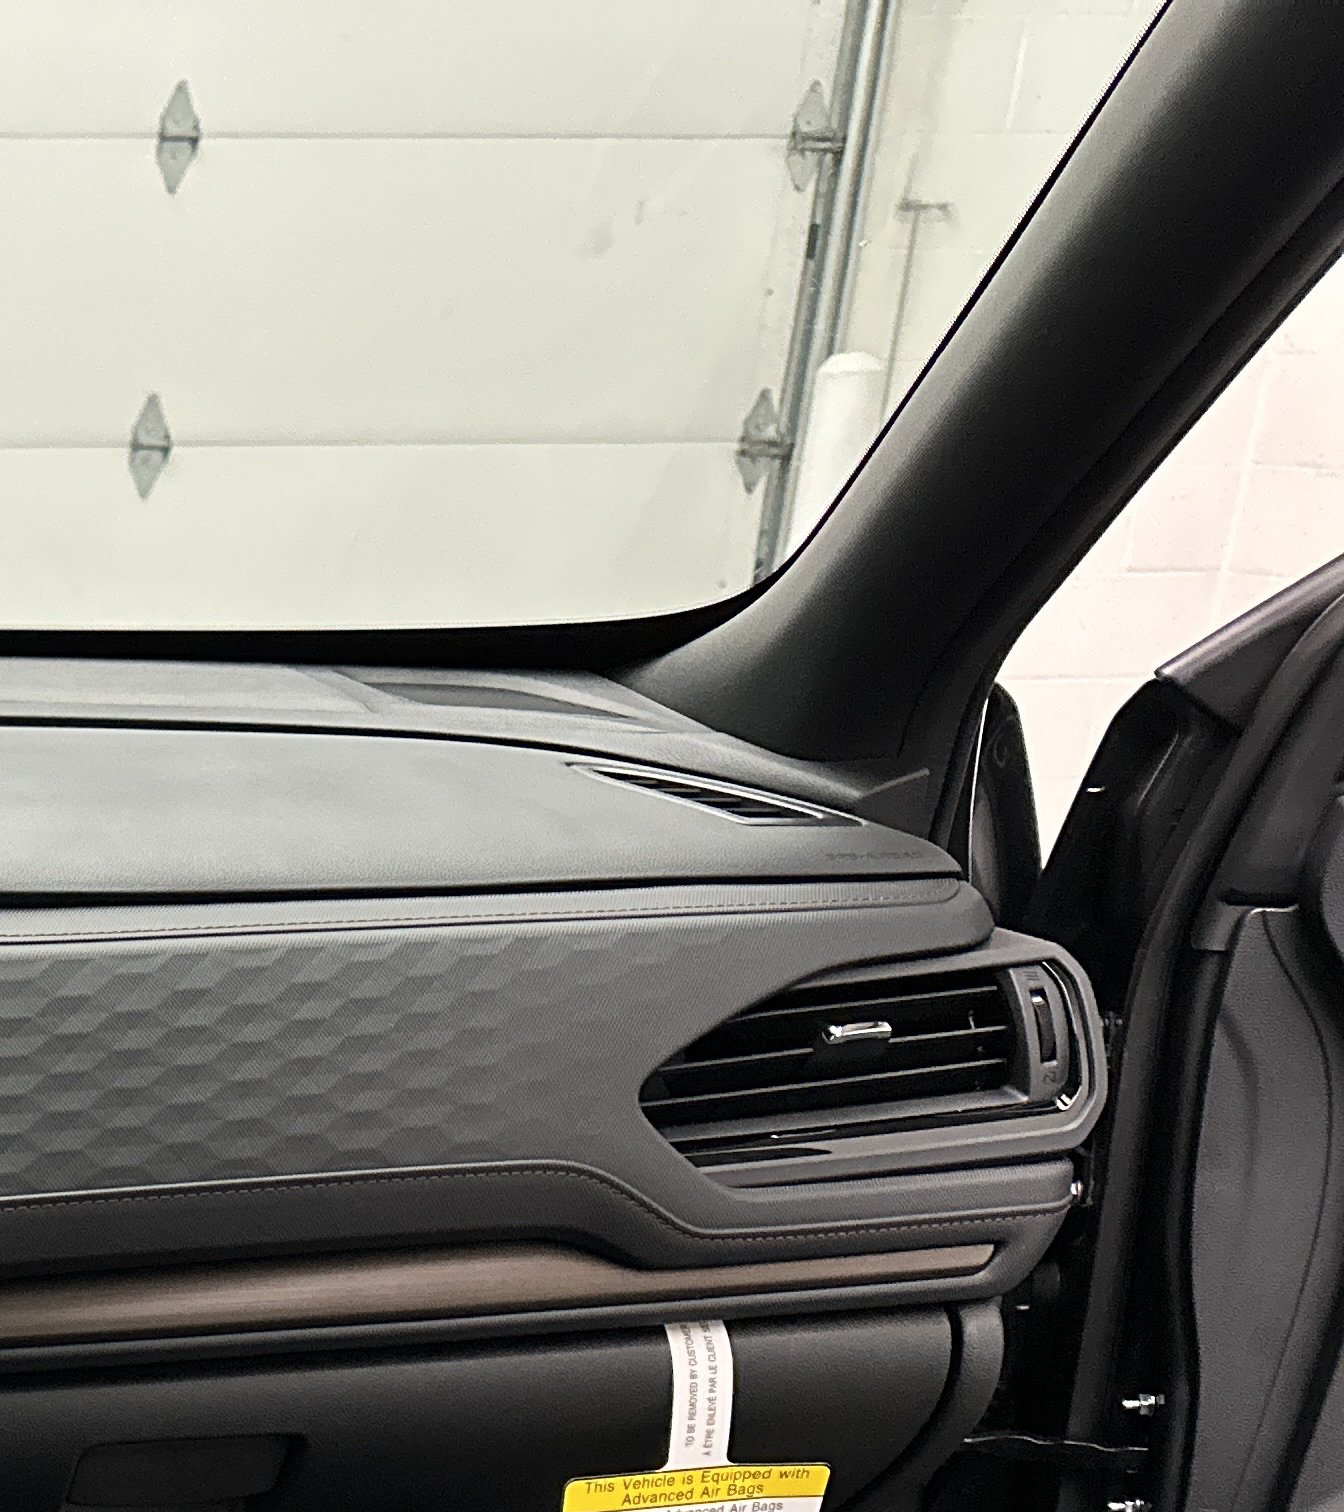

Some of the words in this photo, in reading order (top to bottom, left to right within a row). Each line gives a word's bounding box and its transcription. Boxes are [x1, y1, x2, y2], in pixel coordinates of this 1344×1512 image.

[704, 1335, 717, 1362] CLIENT
[690, 1368, 698, 1380] BY
[708, 1364, 717, 1374] LE
[708, 1377, 717, 1393] PAR
[688, 1382, 698, 1421] REMOVED
[687, 1423, 696, 1434] BE
[685, 1435, 695, 1448] TO
[585, 1482, 614, 1494] This
[623, 1475, 675, 1490] Vehicle
[682, 1474, 693, 1484] is
[701, 1469, 772, 1484] Equipped
[779, 1468, 810, 1479] with
[621, 1488, 694, 1506] Advanced
[700, 1486, 720, 1498] Air
[727, 1483, 764, 1498] Bags
[752, 1502, 783, 1512] Bags
